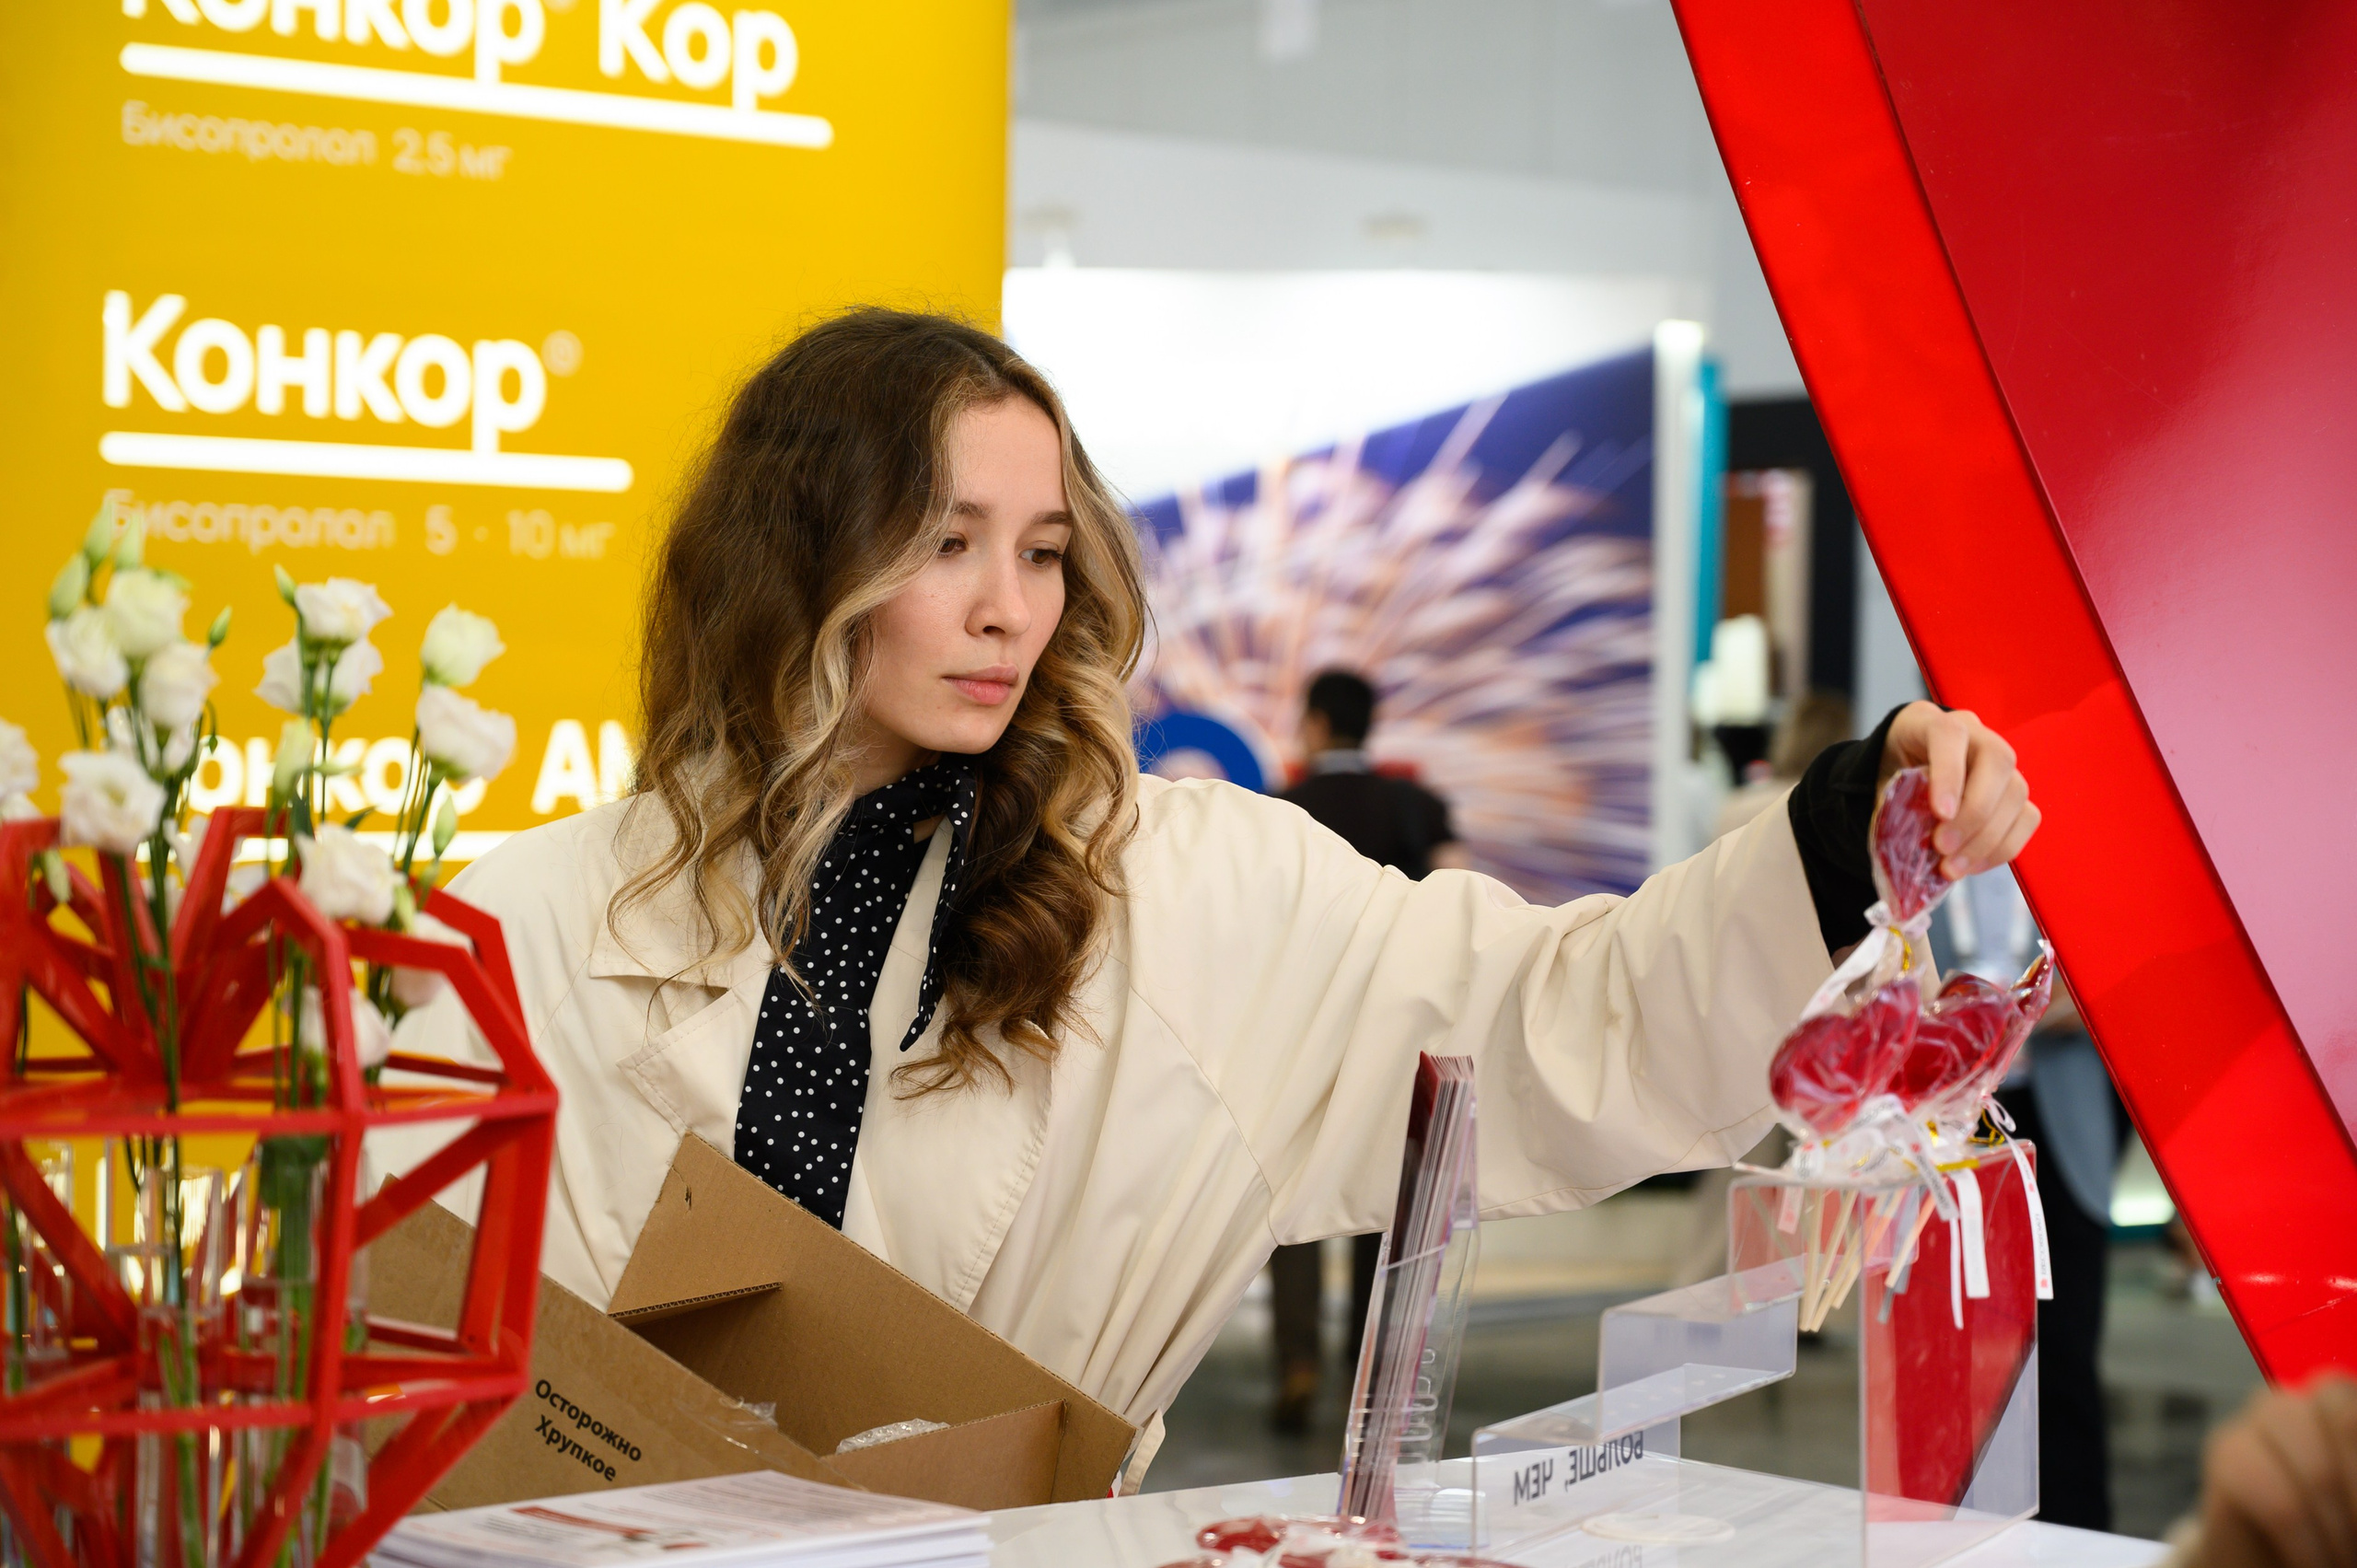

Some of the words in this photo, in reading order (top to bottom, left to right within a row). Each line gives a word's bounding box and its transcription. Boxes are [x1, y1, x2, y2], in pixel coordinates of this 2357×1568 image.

[122, 0, 546, 82] кор
[598, 0, 799, 109] Кор
[424, 504, 458, 555] 5
[505, 509, 555, 560] 10
[535, 1379, 642, 1462] Осторожно
[535, 1414, 617, 1482] Хрупкое
